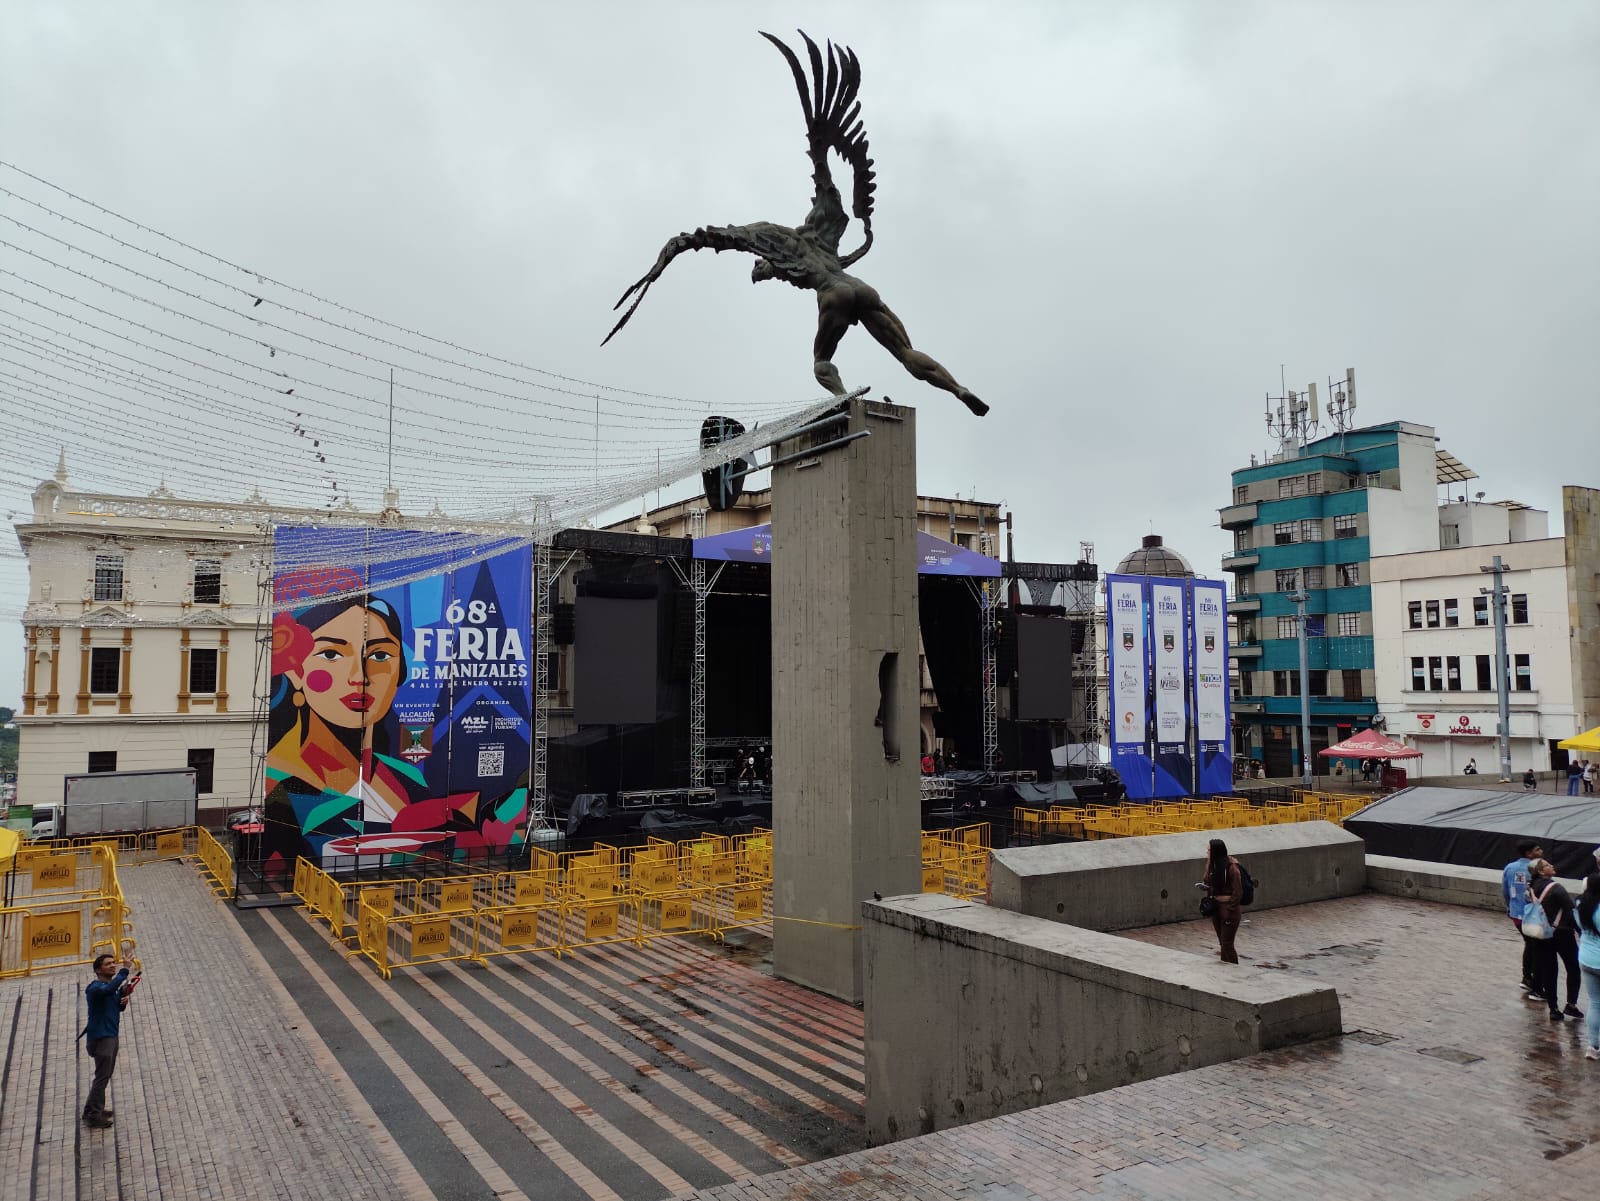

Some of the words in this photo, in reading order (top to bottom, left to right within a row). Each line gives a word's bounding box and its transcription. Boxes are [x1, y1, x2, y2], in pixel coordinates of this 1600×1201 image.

[413, 627, 526, 662] FERIA
[411, 667, 430, 680] DE
[434, 663, 528, 680] MANIZALES
[400, 710, 435, 718] ALCALDÍA
[40, 869, 70, 880] AMARILLO
[31, 932, 71, 947] AMARILLO
[418, 932, 445, 945] AMARILLO
